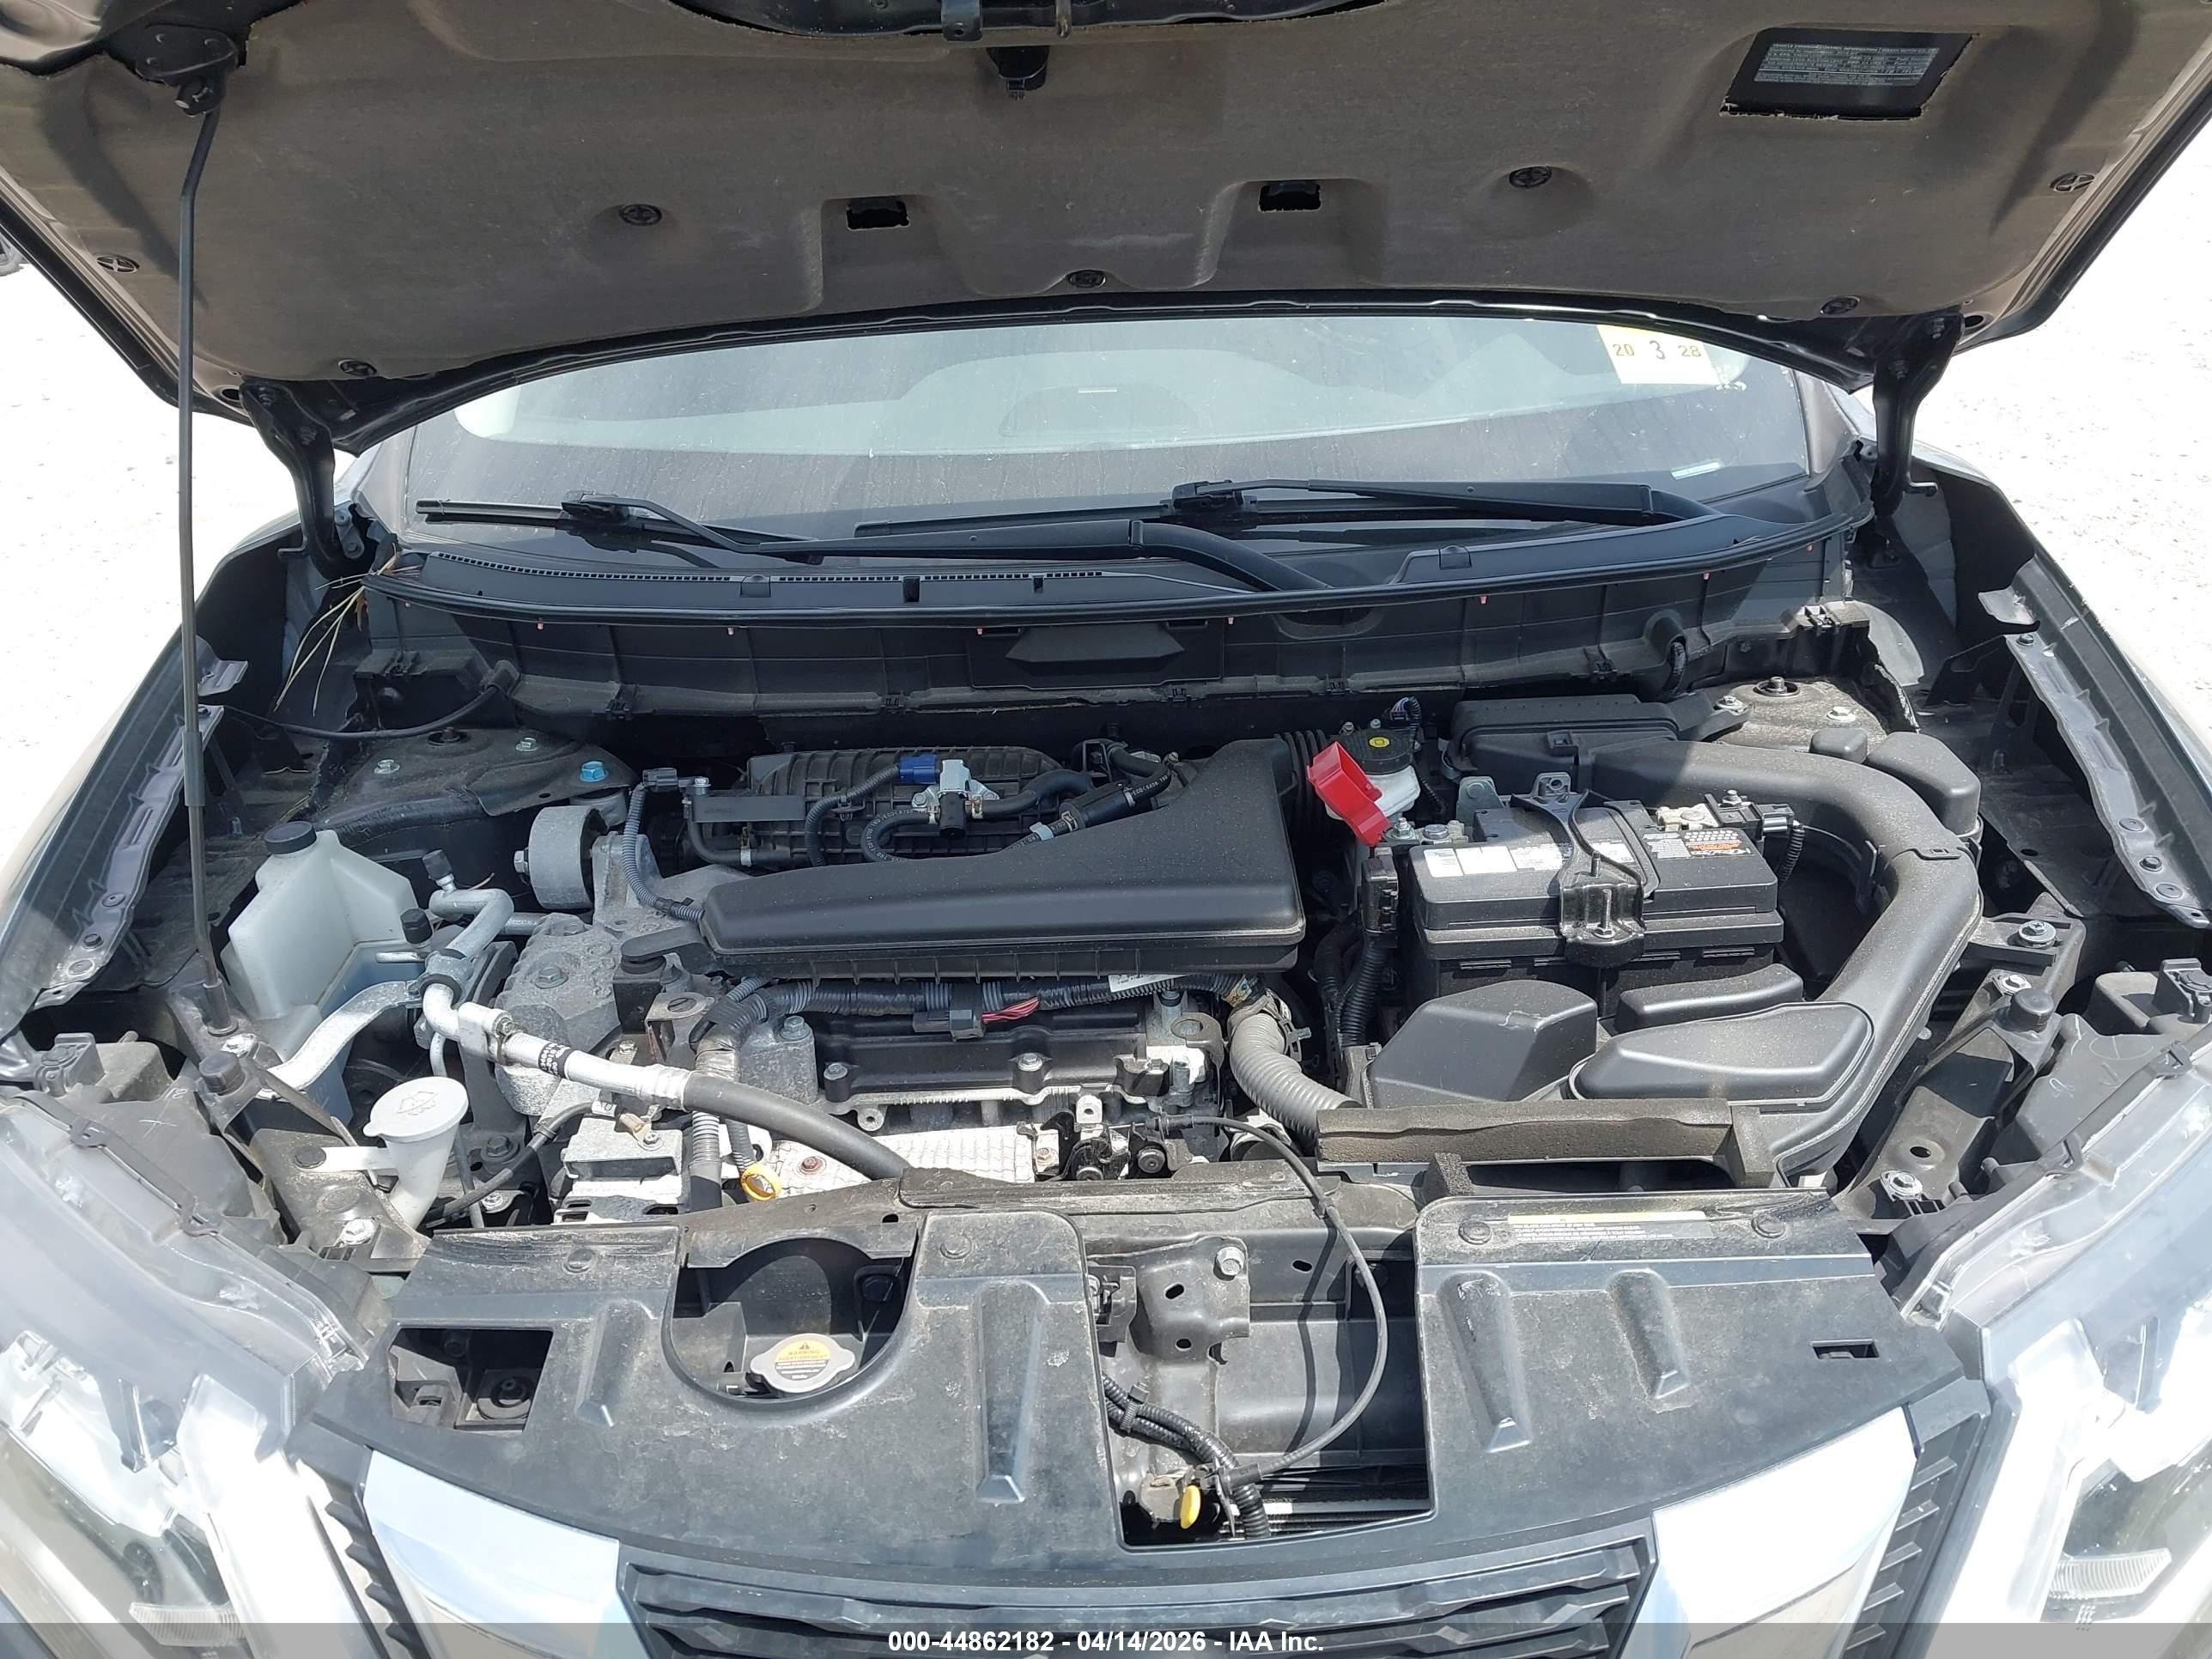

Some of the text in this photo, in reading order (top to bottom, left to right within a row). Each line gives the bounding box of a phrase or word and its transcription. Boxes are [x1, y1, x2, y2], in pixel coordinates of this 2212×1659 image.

[1613, 340, 1702, 360] 20 3 28
